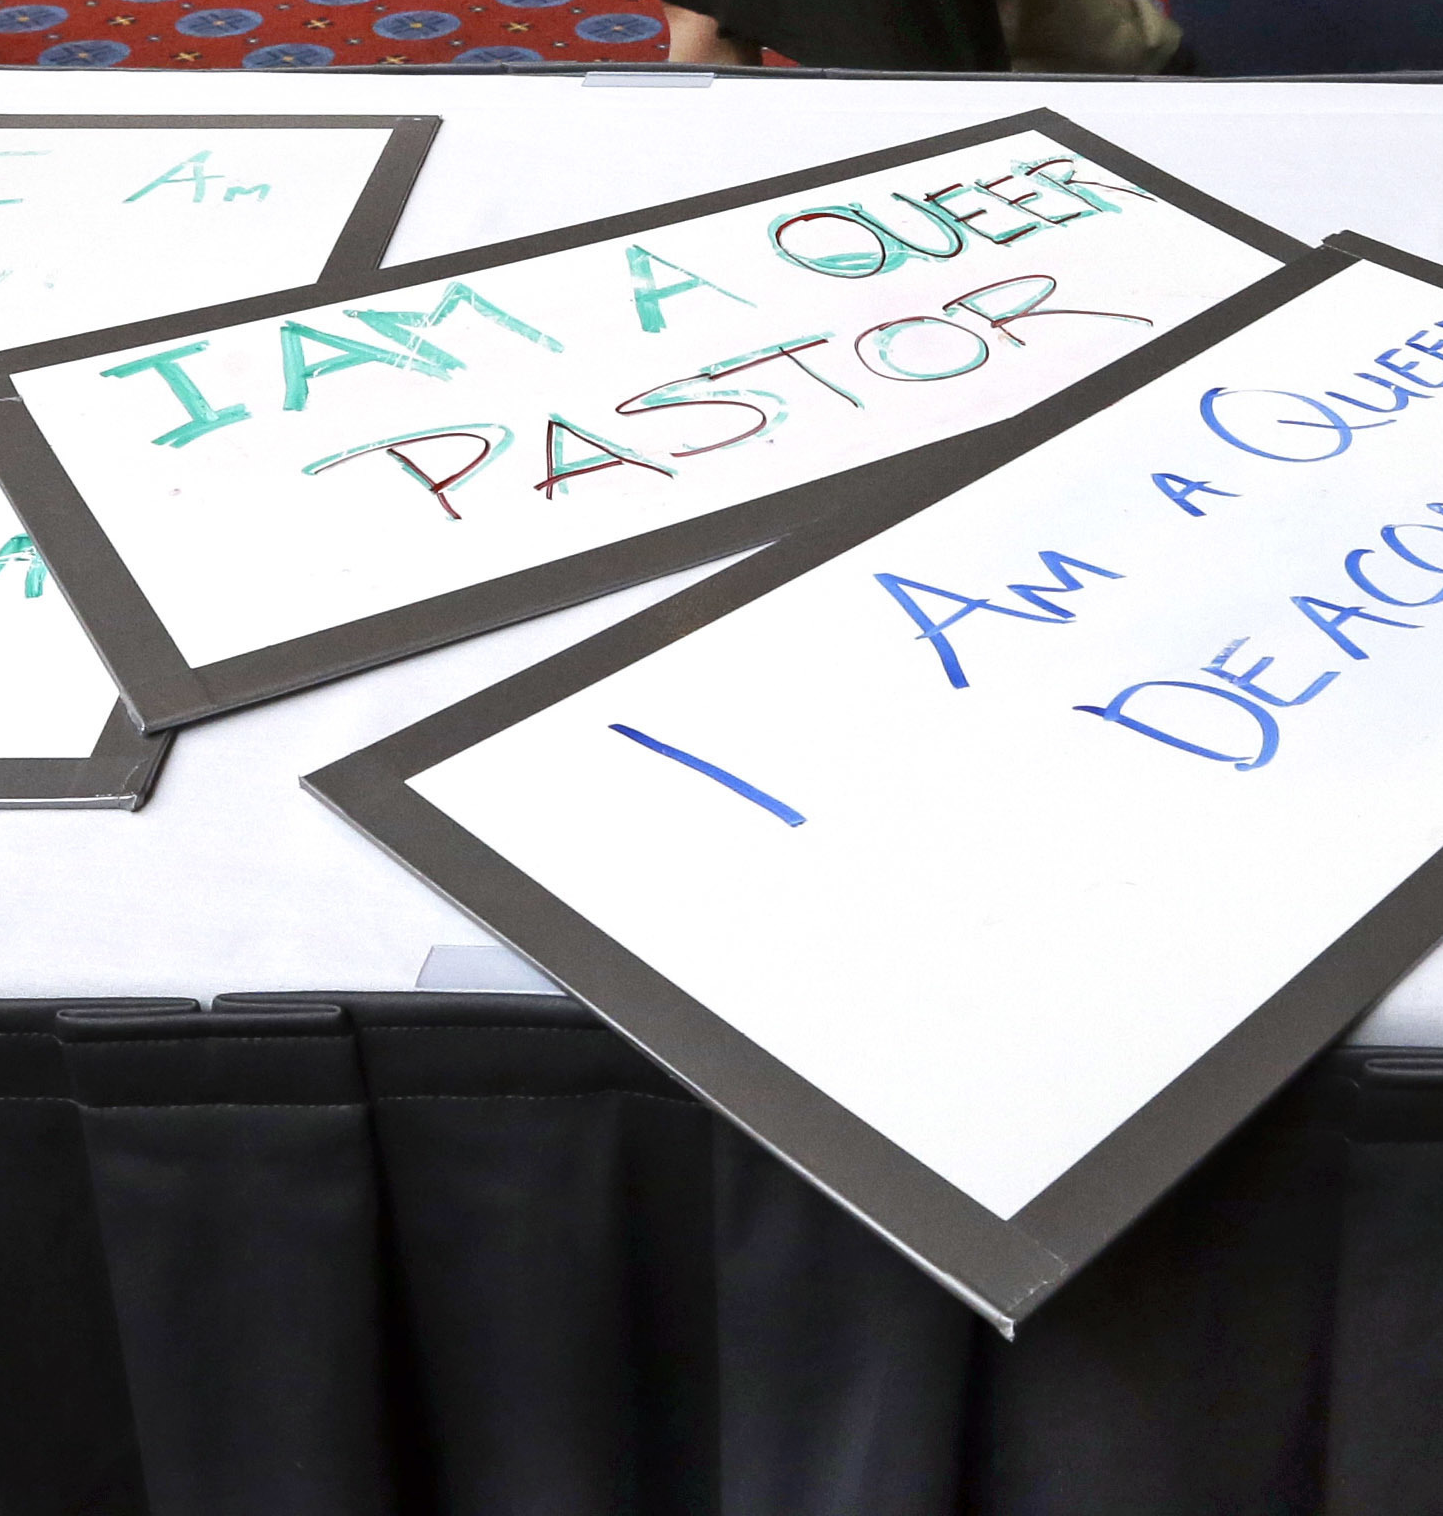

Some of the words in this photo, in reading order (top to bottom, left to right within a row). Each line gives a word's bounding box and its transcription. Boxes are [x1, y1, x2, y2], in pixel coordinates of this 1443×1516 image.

[99, 339, 252, 448] I
[281, 281, 565, 411] AM
[625, 245, 760, 334] A
[767, 153, 1158, 280] QUEER
[301, 274, 1154, 520] PASTOR
[608, 723, 807, 828] I
